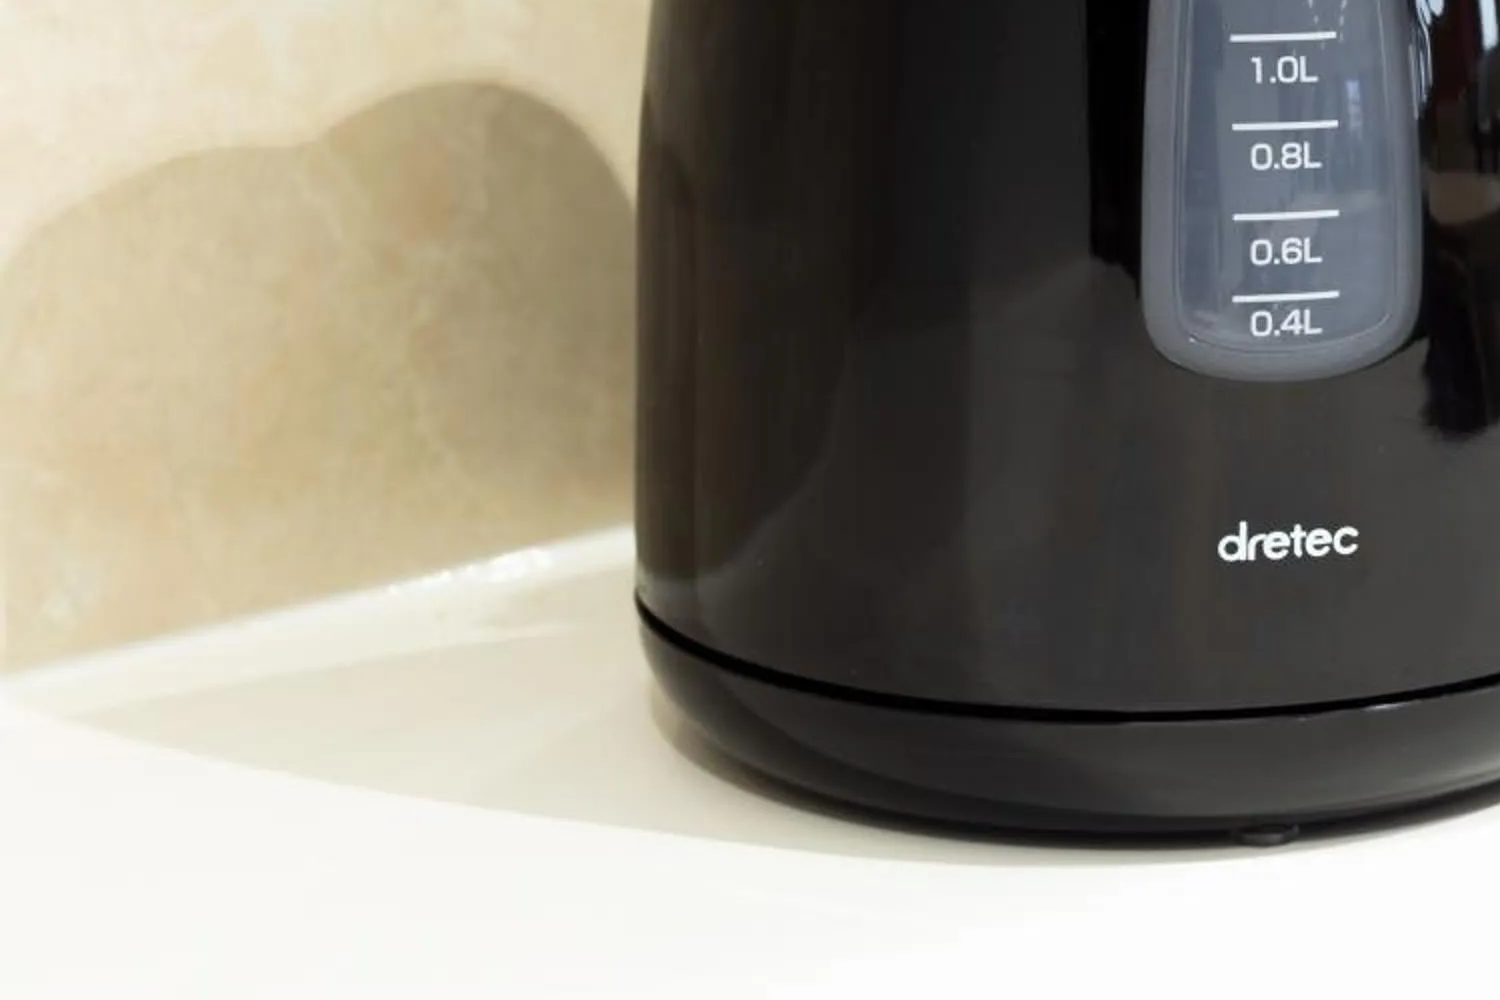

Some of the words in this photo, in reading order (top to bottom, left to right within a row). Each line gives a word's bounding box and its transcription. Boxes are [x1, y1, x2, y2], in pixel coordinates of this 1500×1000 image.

[1250, 55, 1319, 85] 1.0L
[1250, 141, 1322, 171] 0.8L
[1250, 237, 1323, 267] 0.6L
[1250, 308, 1323, 338] 0.4L
[1217, 520, 1360, 562] dretec
